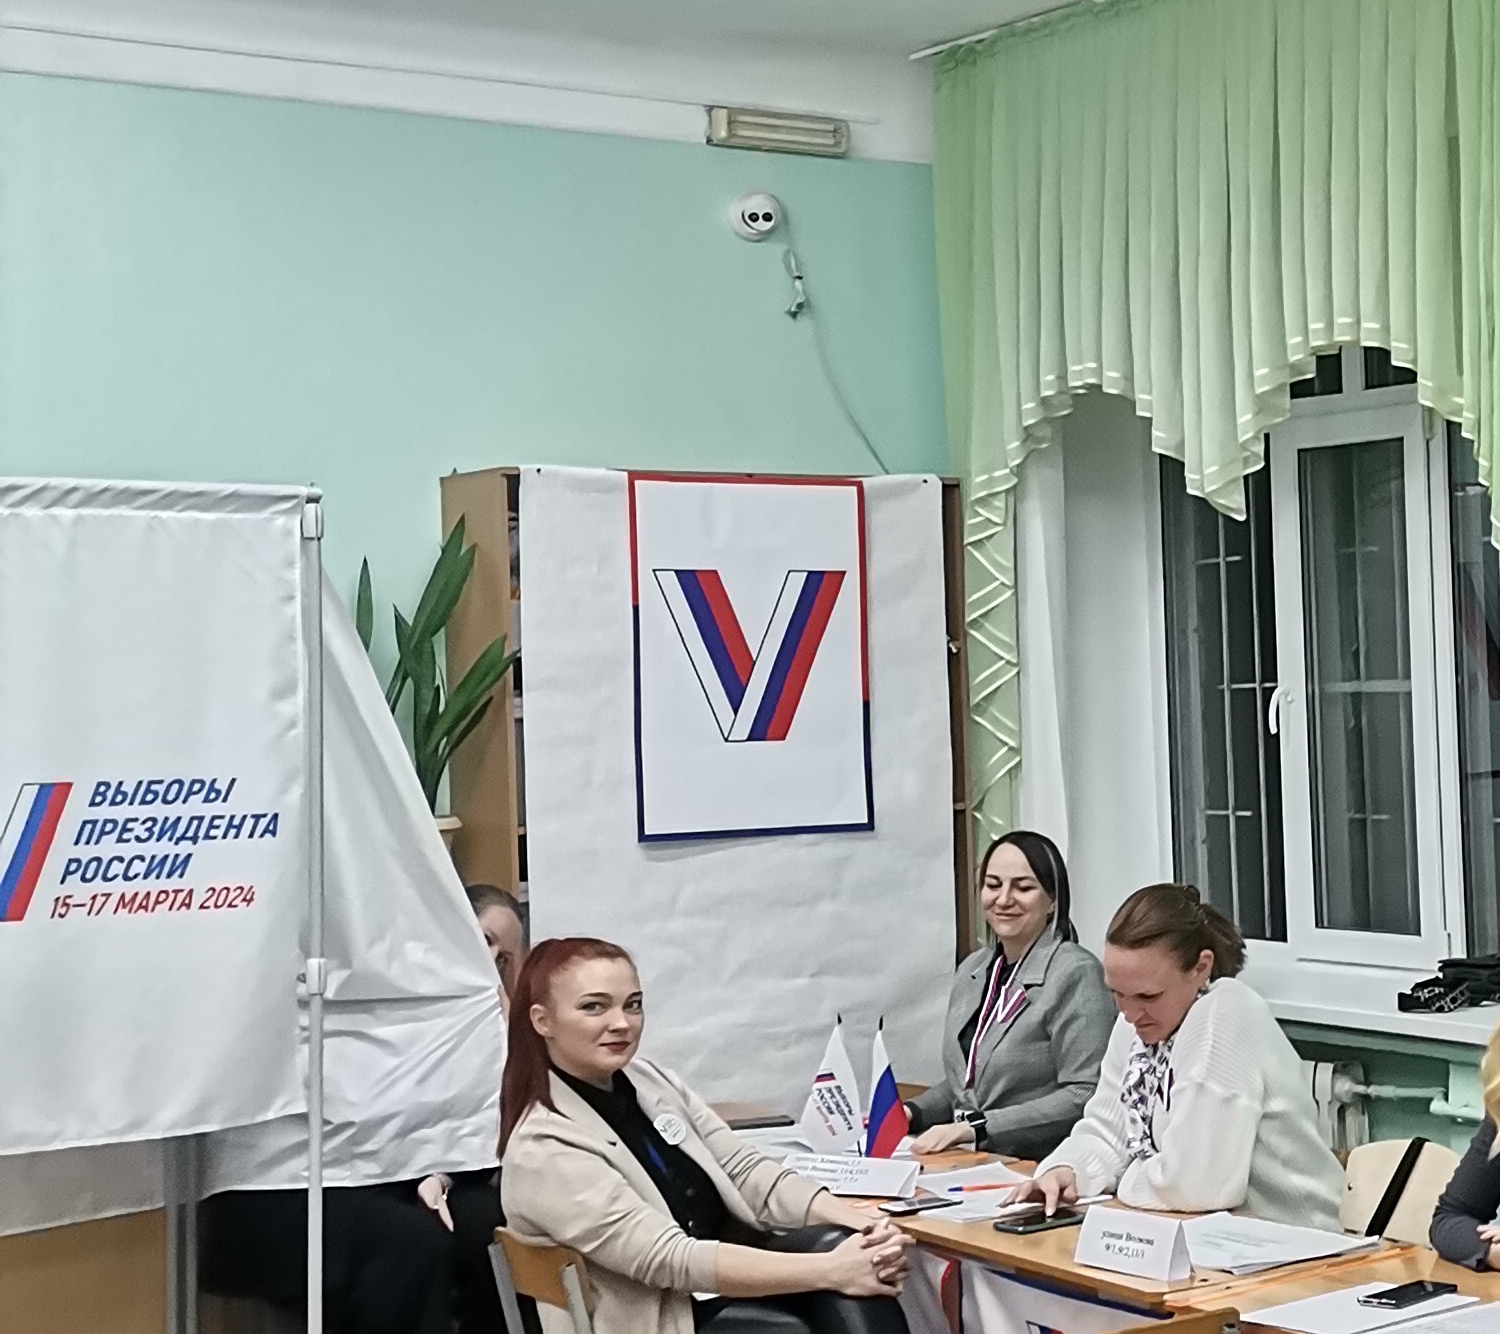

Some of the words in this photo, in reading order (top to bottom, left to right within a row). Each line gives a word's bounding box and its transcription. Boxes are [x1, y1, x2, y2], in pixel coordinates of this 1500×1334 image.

[88, 778, 237, 808] ВЫБОРЫ
[73, 812, 279, 846] ПРЕЗИДЕНТА
[60, 853, 193, 885] РОССИИ
[113, 888, 194, 915] МАРТА
[199, 886, 256, 910] 2024
